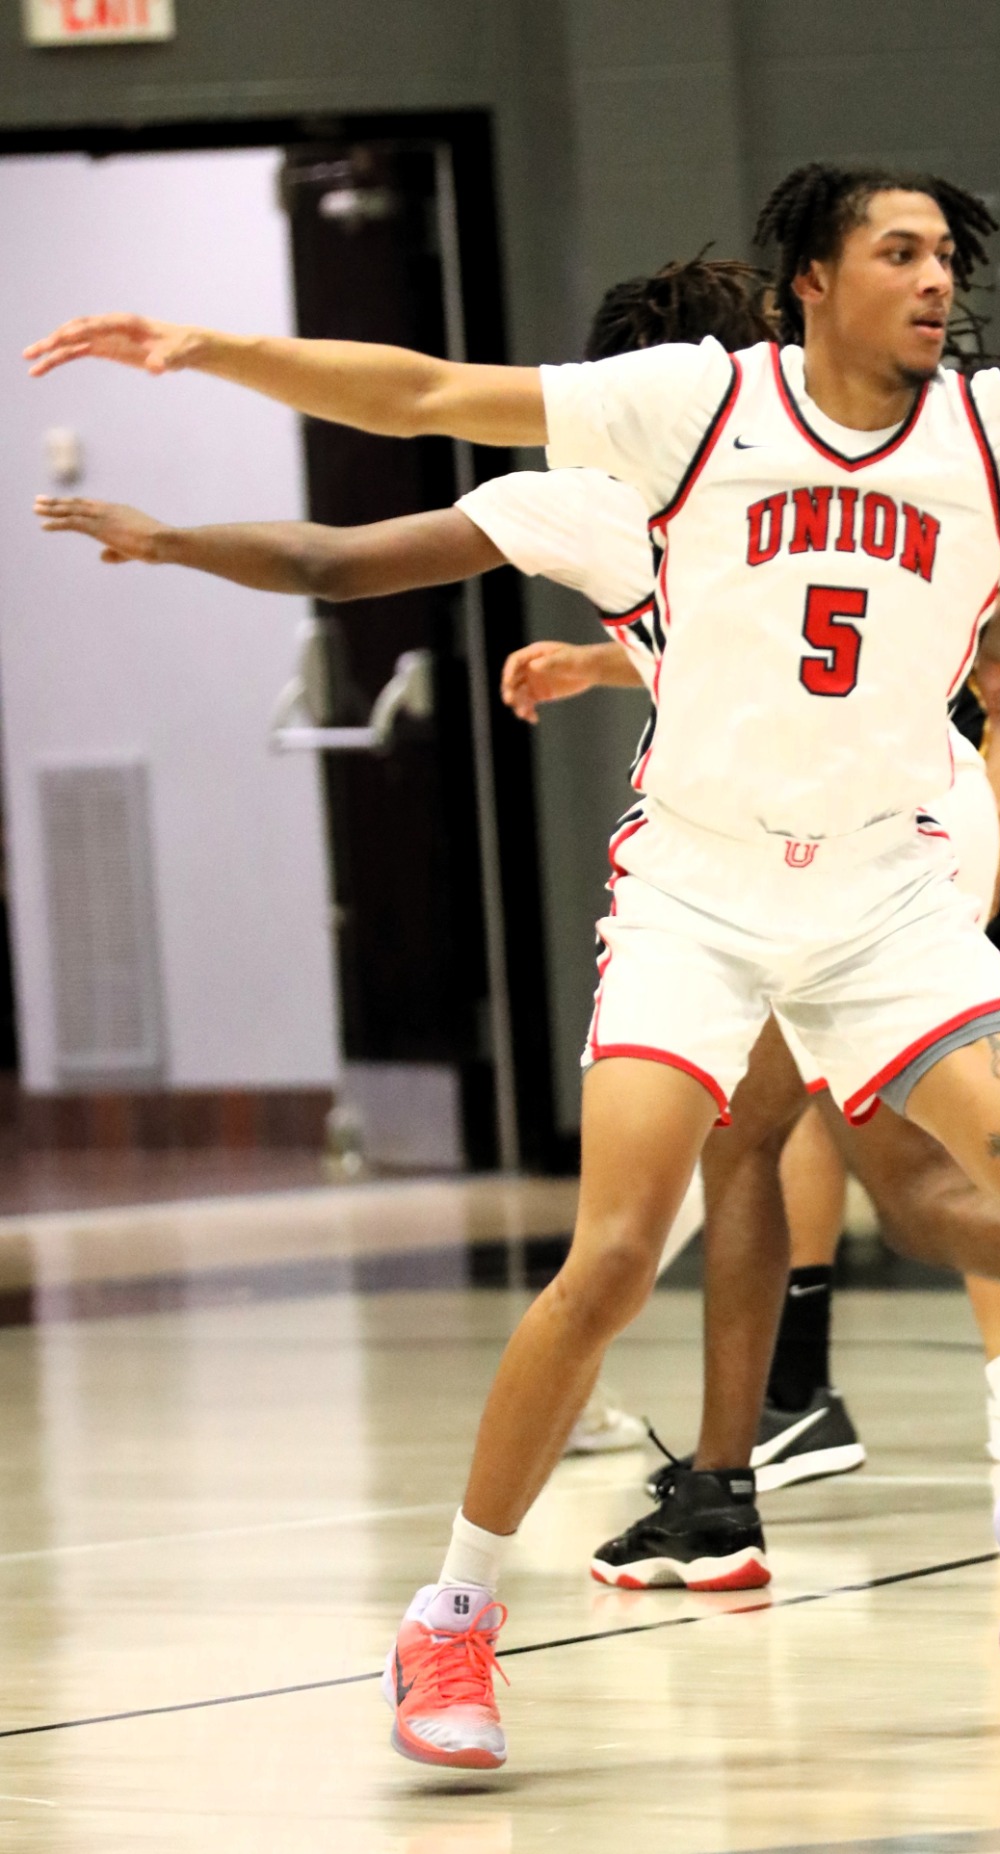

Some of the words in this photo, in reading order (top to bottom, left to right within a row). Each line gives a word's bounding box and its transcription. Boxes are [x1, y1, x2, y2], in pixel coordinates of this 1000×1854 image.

[746, 486, 941, 583] UNION
[799, 584, 868, 697] 5
[784, 840, 820, 868] U
